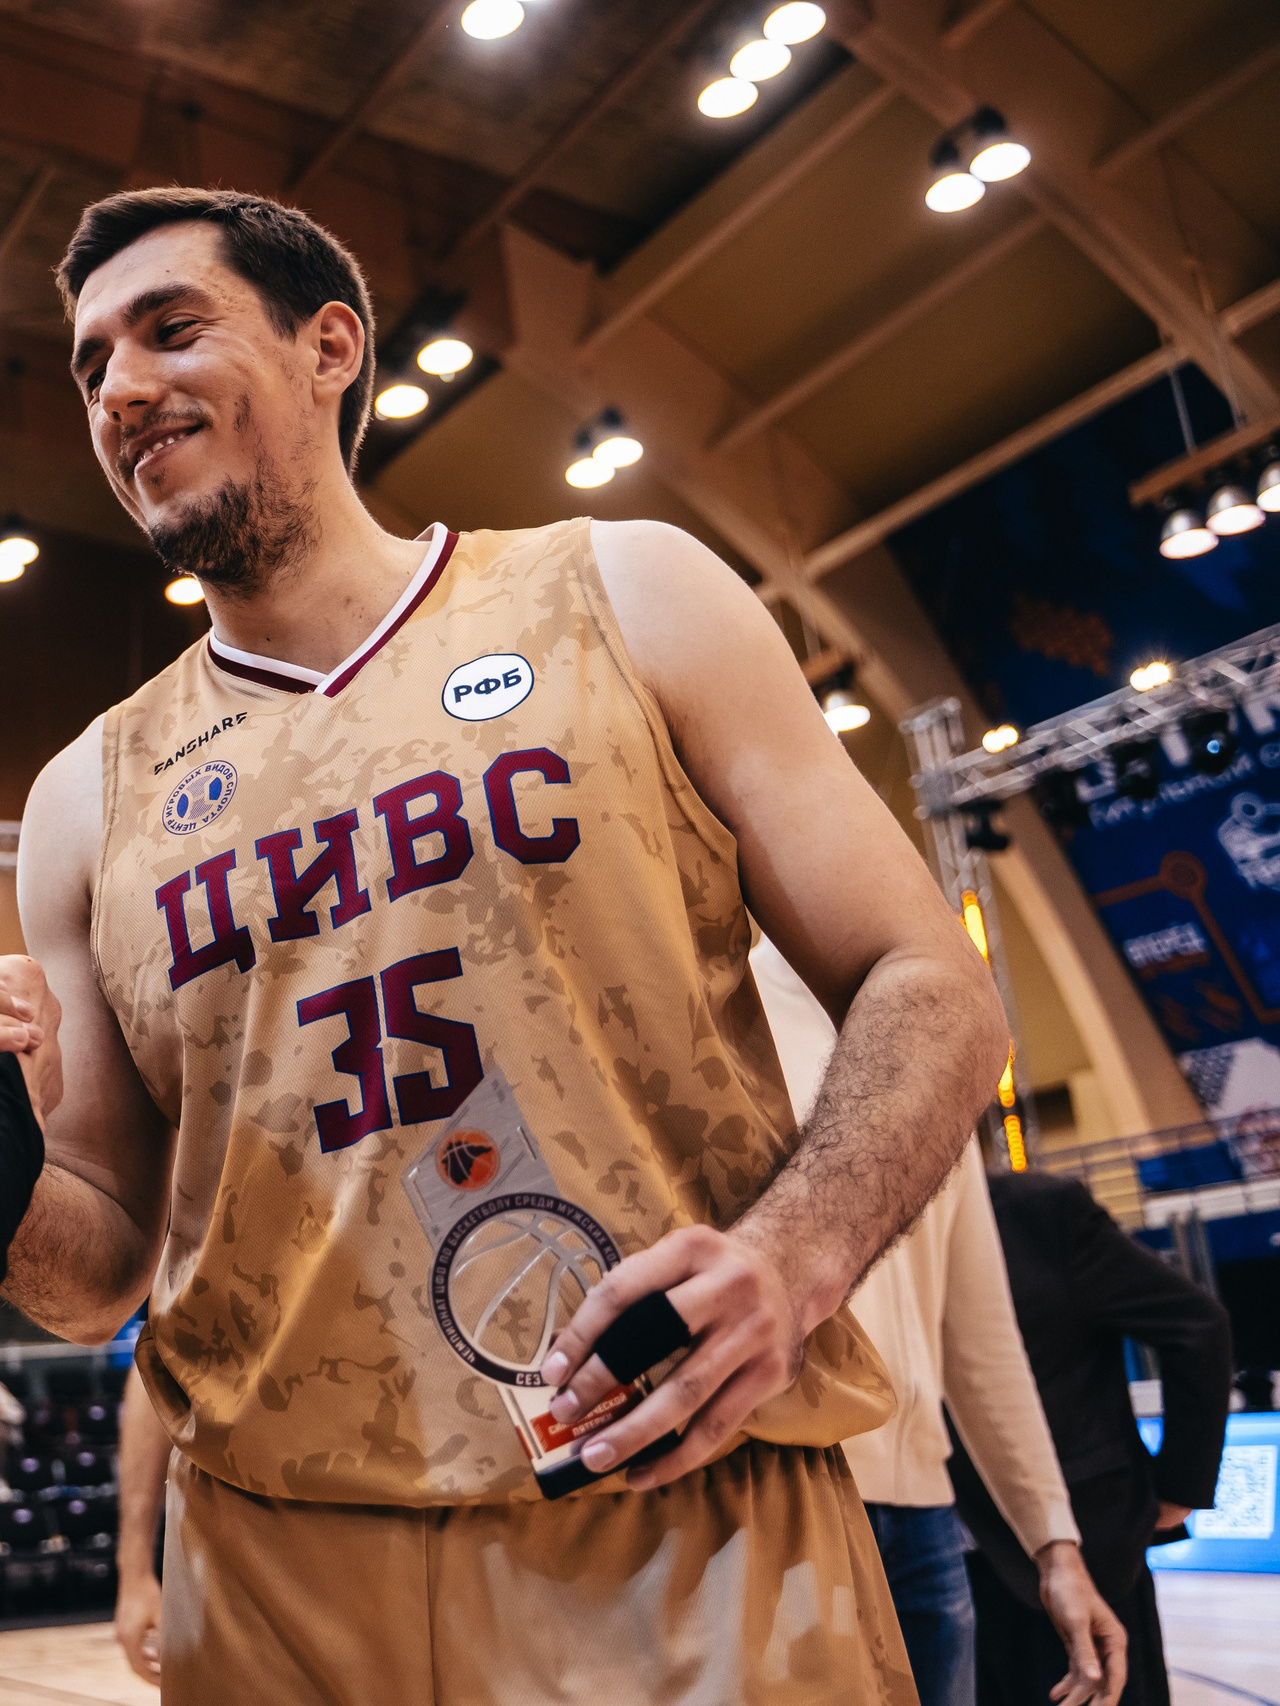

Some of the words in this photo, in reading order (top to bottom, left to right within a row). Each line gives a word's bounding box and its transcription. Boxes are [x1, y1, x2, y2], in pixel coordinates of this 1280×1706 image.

[452, 667, 522, 704] РФБ
[165, 768, 203, 818] ИГРОВЫХ
[204, 764, 234, 781] ВИДОВ
[201, 781, 235, 823] СПОРТА
[167, 818, 197, 832] ЦЕНТР
[155, 747, 581, 991] ЦИВС
[297, 946, 485, 1154] 35
[450, 1197, 512, 1244] БАСКЕТБОЛУ
[514, 1195, 555, 1209] СРЕДИ
[557, 1202, 608, 1245] МУЖСКИХ
[438, 1248, 453, 1264] ПО
[434, 1292, 477, 1364] ЧЕМПИОНАТ
[515, 1372, 544, 1386] СЕЗ
